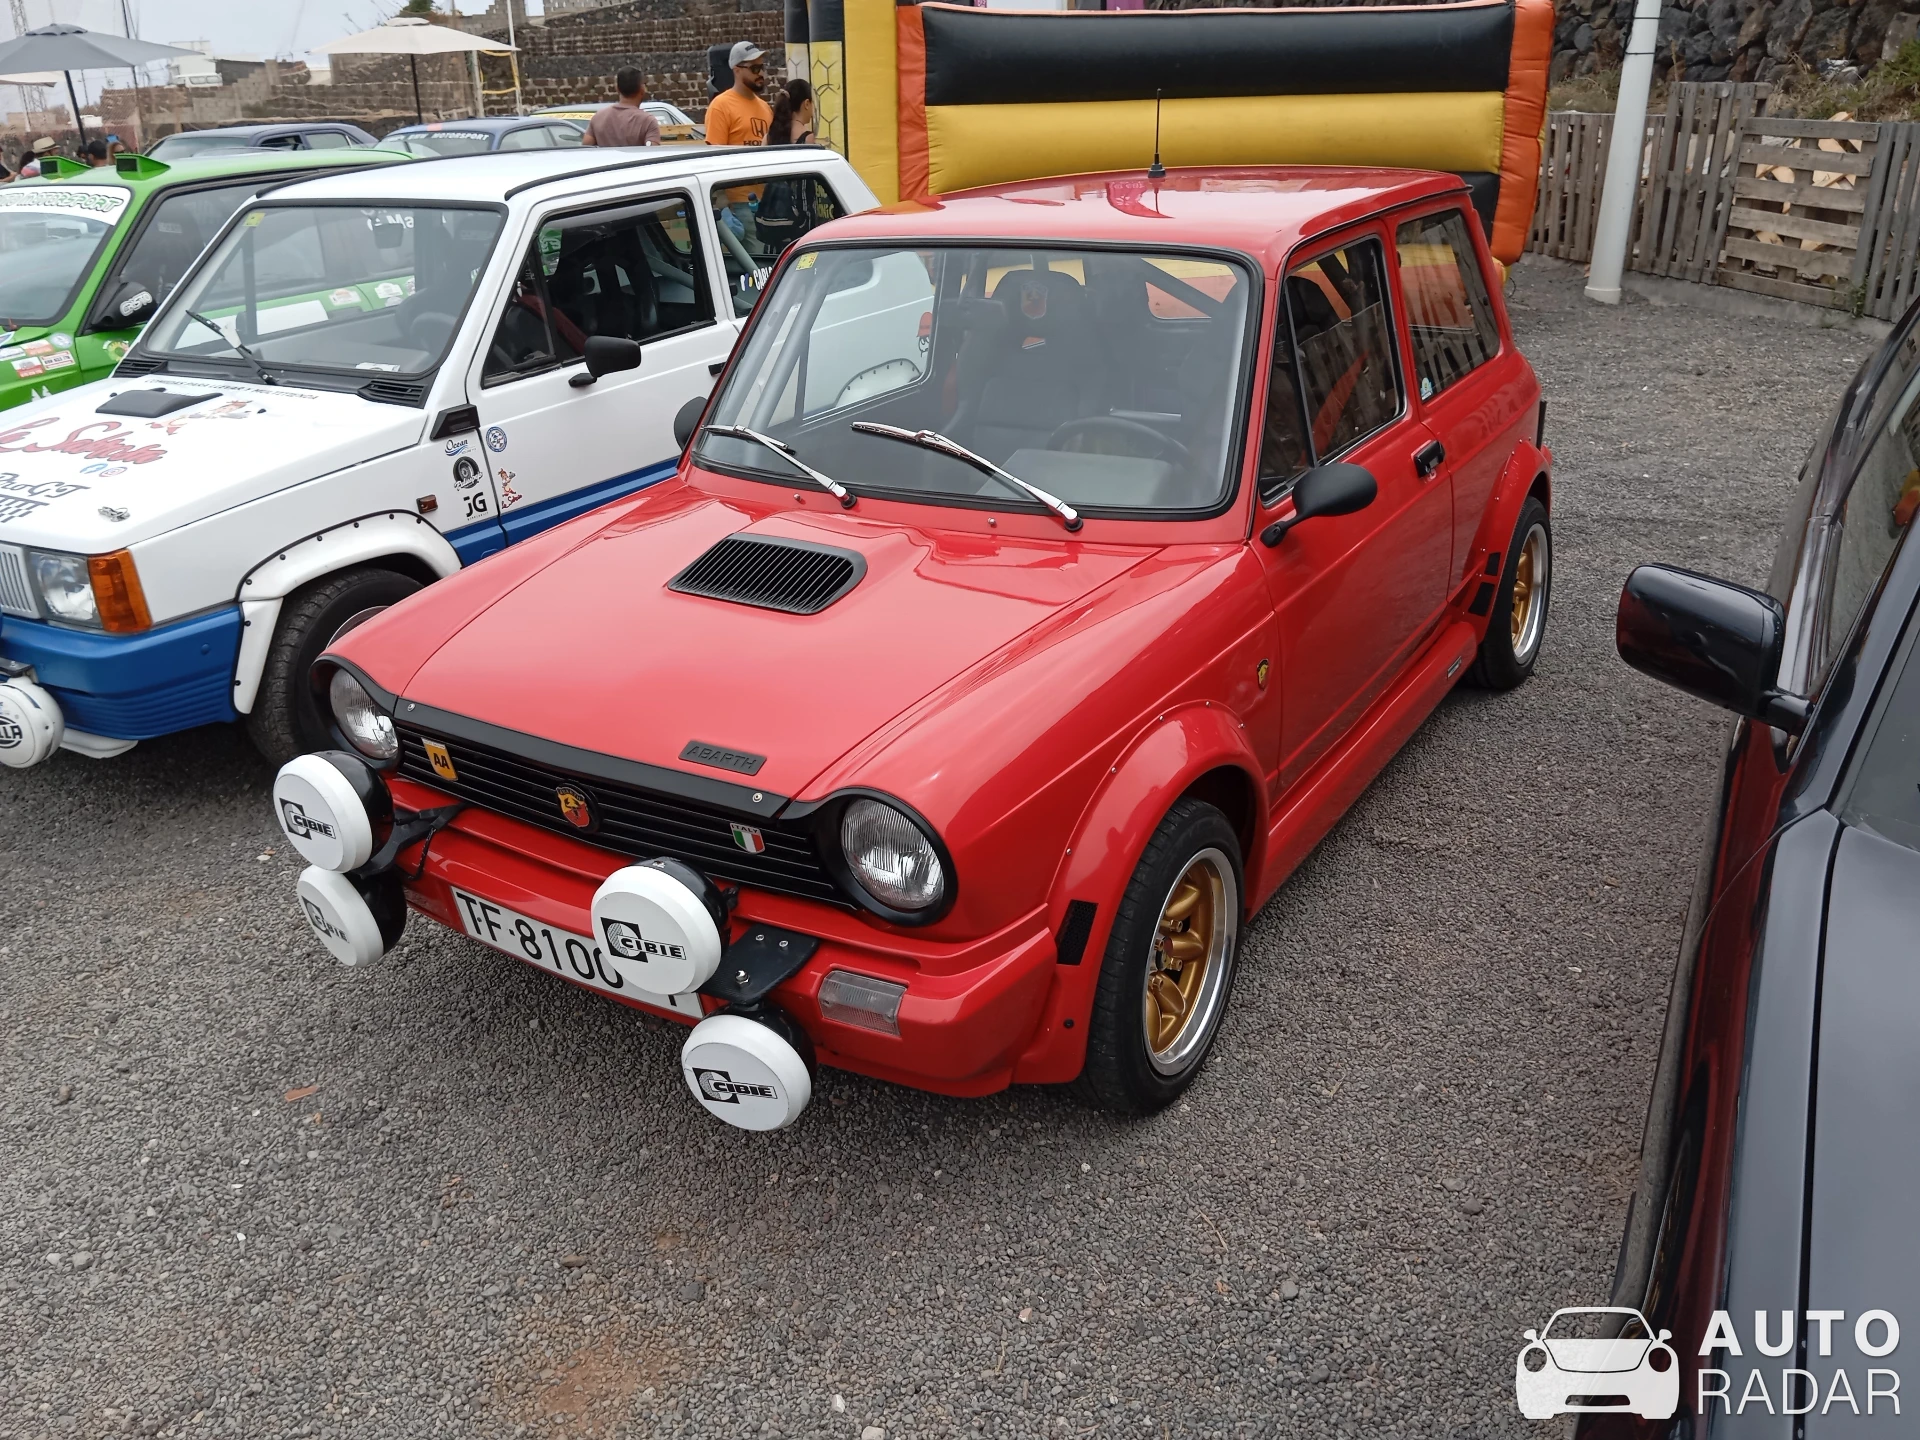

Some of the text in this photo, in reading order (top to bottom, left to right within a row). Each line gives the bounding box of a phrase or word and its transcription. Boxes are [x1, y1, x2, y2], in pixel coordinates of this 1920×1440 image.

[431, 132, 490, 141] MOTORSPORT
[446, 439, 468, 451] Ocean
[433, 752, 451, 770] AA
[686, 745, 757, 770] ABARTH
[293, 813, 334, 837] CIBIE
[731, 824, 758, 834] ITALY
[314, 913, 349, 942] CIBIE
[620, 937, 684, 959] CIBIE
[712, 1080, 774, 1097] CIBIE
